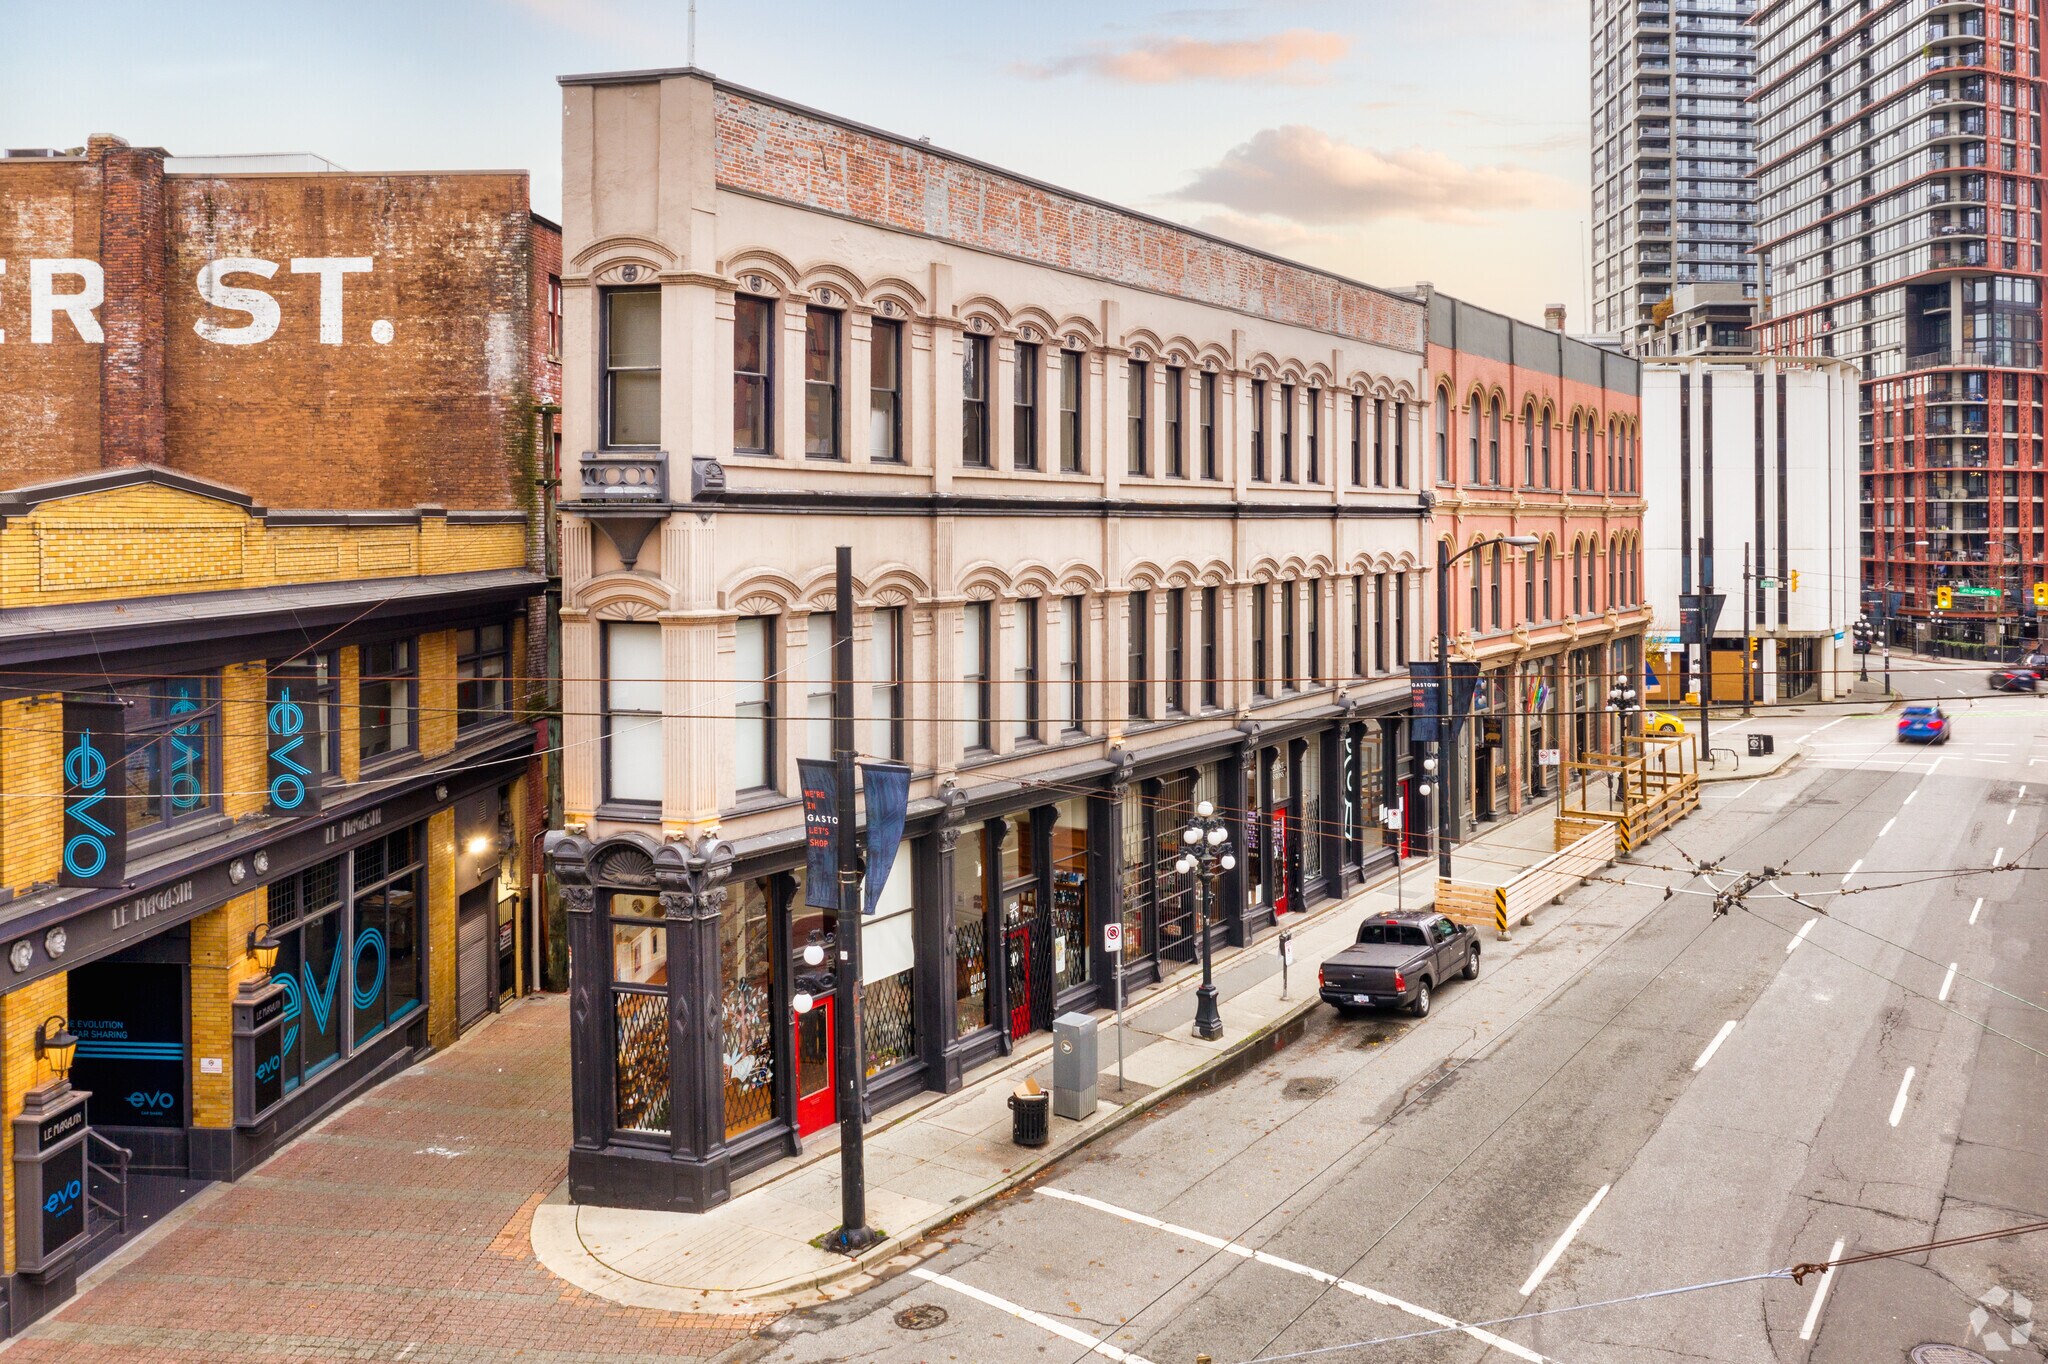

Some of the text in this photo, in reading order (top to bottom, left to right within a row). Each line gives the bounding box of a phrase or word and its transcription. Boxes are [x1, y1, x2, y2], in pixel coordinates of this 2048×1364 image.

[0, 256, 395, 344] R ST.
[804, 789, 825, 799] WE'RE
[807, 802, 816, 810] IN
[325, 808, 382, 844] LE MAGASIN
[809, 827, 829, 836] LET'S
[809, 839, 828, 848] SHOP
[111, 880, 192, 930] LE MAGASIN
[72, 1030, 128, 1039] CAR SHARING
[77, 1020, 124, 1029] EVOLUTION
[255, 1054, 280, 1080] evo
[123, 1089, 175, 1109] evo
[44, 1111, 82, 1142] LE MAGASIN
[42, 1180, 81, 1213] evo
